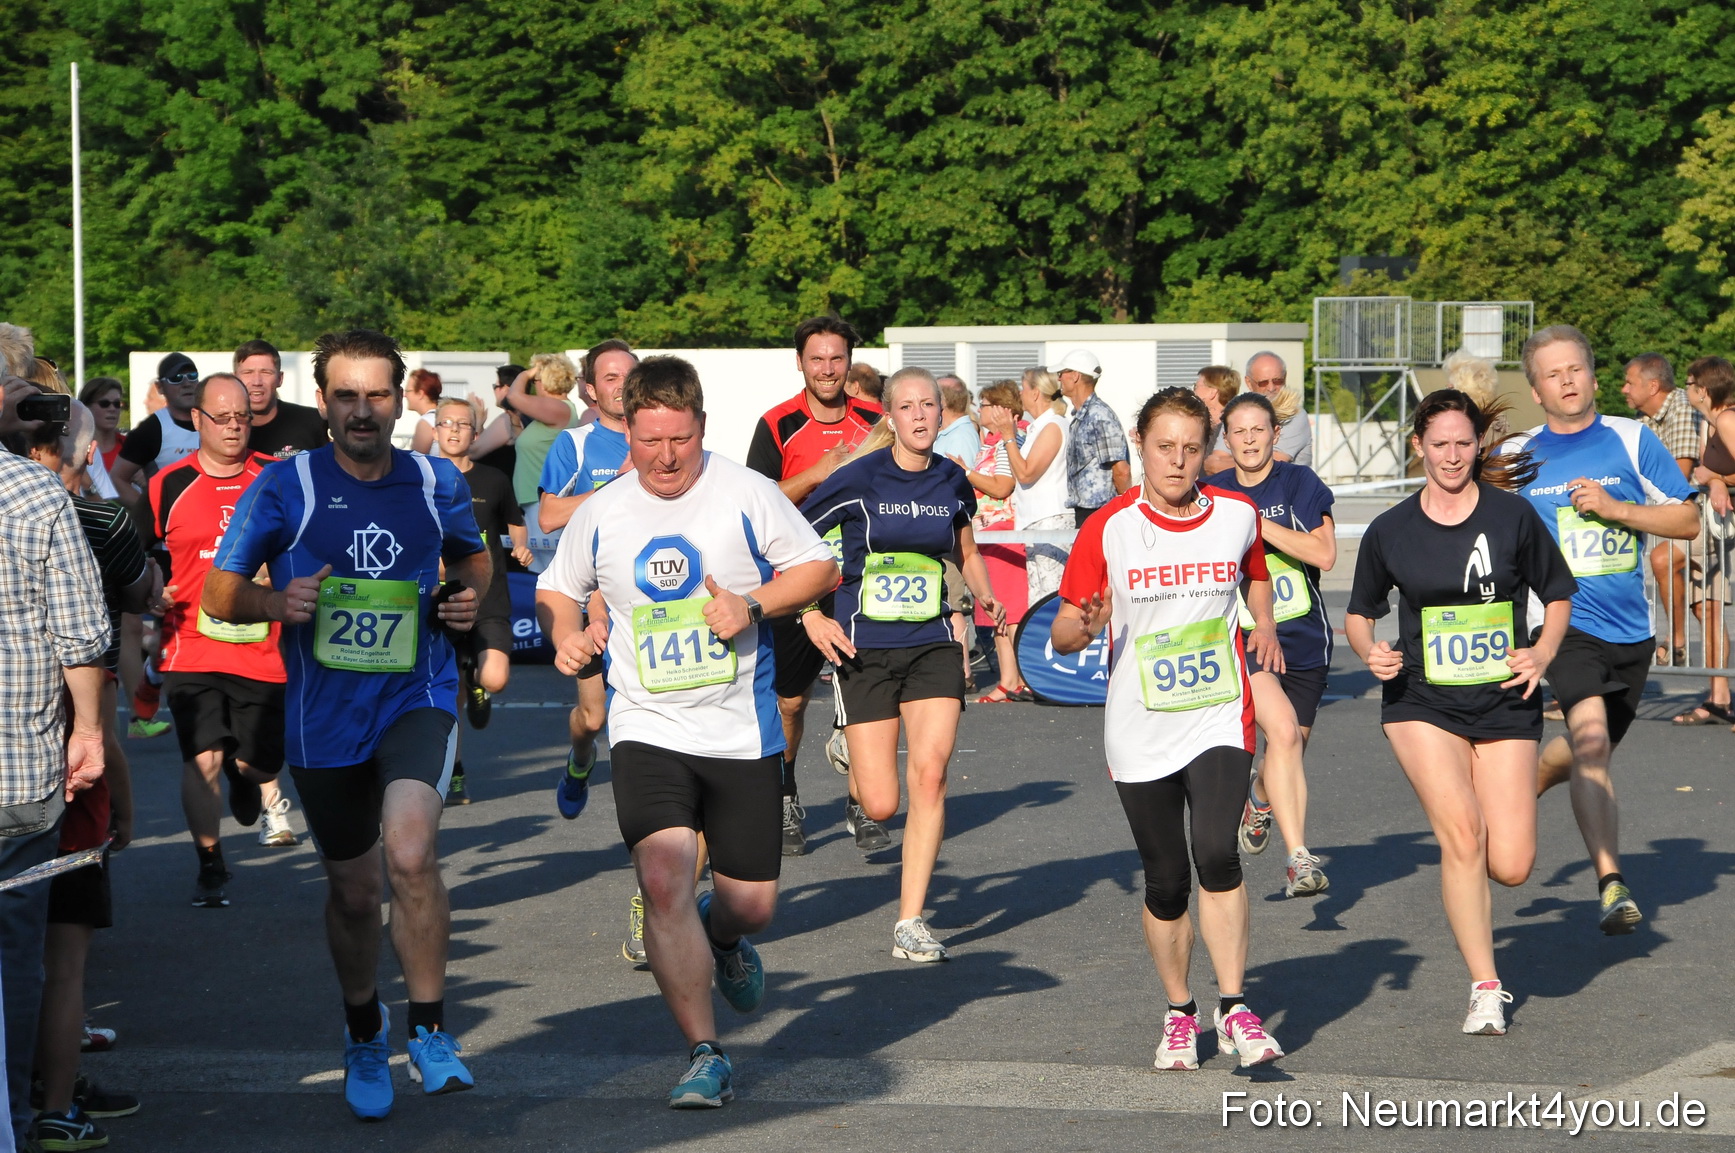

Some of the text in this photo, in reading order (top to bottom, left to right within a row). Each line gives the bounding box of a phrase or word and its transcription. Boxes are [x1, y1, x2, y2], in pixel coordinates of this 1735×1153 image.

[1564, 527, 1634, 559] 1262
[650, 558, 685, 575] TÜV
[660, 578, 678, 588] SÜD
[1128, 561, 1238, 590] PFEIFFER
[875, 575, 928, 604] 323
[1131, 592, 1177, 604] Immobilien
[328, 610, 403, 648] 287
[340, 647, 360, 655] Roland
[639, 628, 730, 669] 1415
[1428, 630, 1509, 666] 1059
[682, 665, 709, 674] Schneider
[688, 672, 709, 680] SERVICE
[1153, 649, 1221, 692] 955
[1191, 686, 1211, 694] Meincke
[1201, 689, 1232, 699] Versicherung
